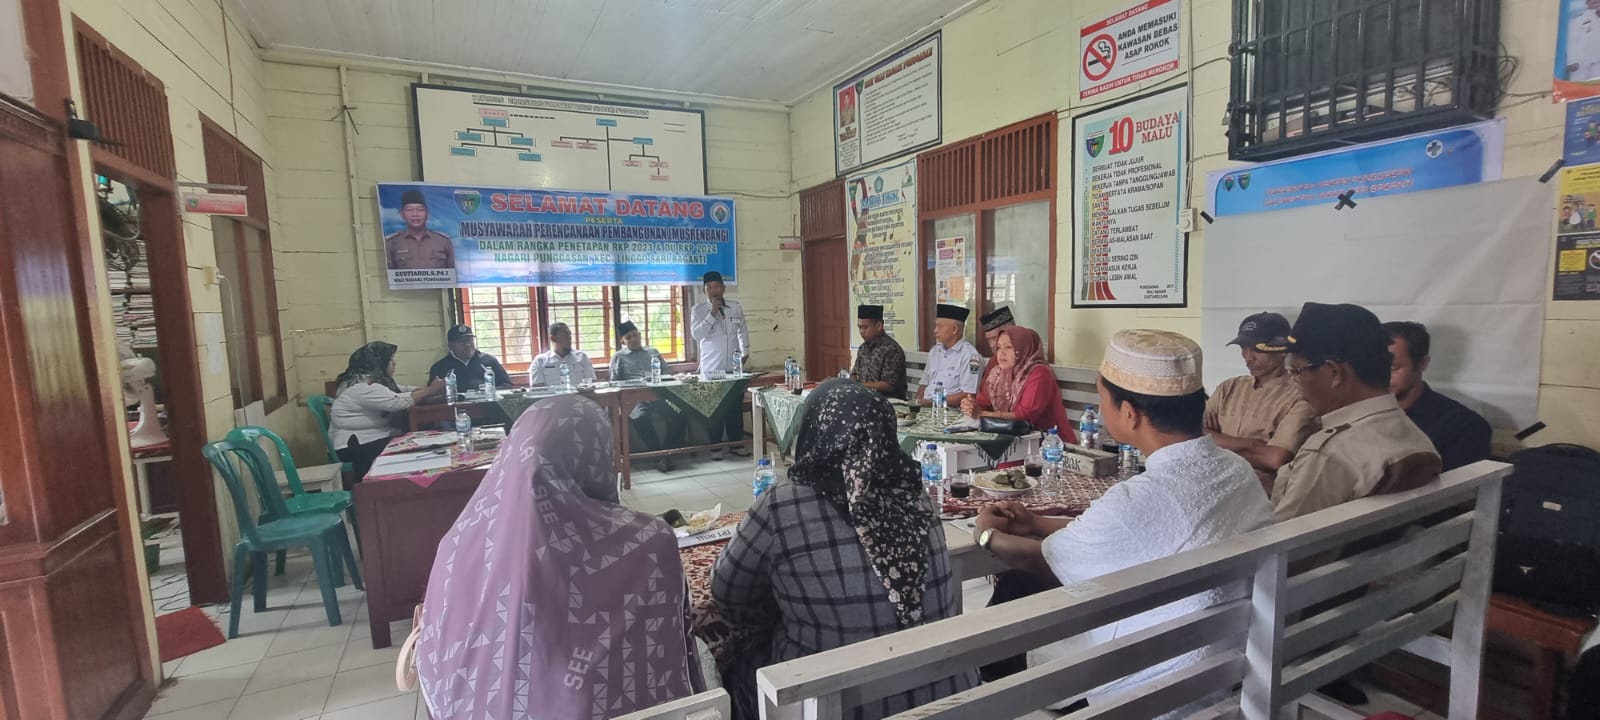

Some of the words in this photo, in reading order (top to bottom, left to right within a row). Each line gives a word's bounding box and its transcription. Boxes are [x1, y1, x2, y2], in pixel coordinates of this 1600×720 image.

[1106, 12, 1128, 26] SELAMAT
[1128, 4, 1149, 16] DATANG
[1118, 28, 1136, 40] ANDA
[1138, 12, 1176, 32] MEMASUKI
[1118, 34, 1152, 51] KAWASAN
[1154, 24, 1178, 38] BEBAS
[1124, 48, 1142, 60] ASAP
[1144, 37, 1170, 53] ROKOK
[1082, 86, 1098, 96] TERIMA
[1100, 82, 1114, 92] KASIH
[1115, 77, 1132, 87] UNTUK
[1132, 72, 1146, 80] TIDAK
[1148, 63, 1175, 76] MEROKOK
[1109, 117, 1134, 155] 10
[1136, 112, 1179, 132] BUDAYA
[1142, 126, 1173, 143] MALU
[1092, 160, 1113, 172] BERBUAT
[1114, 160, 1127, 168] TIDAK
[1128, 156, 1144, 166] JUJUR
[1092, 172, 1112, 182] BEKERJA
[1114, 169, 1126, 178] TIDAK
[1128, 163, 1162, 174] PROFESIONAL
[1092, 180, 1112, 190] BEKERJA
[1114, 178, 1128, 186] TANPA
[1130, 170, 1176, 183] TANGGUNGJAWAB
[1128, 182, 1164, 194] KRAMA/SOPAN
[491, 193, 608, 216] SELAMAT
[616, 199, 704, 220] DATANG
[1092, 208, 1128, 218] MENINGGALKAN
[1128, 204, 1144, 213] TUGAS
[1146, 201, 1170, 210] SEBELUM
[460, 222, 532, 238] MUSYAWARAH
[534, 223, 600, 239] PERENCANAAN
[602, 226, 667, 240] PEMBANGUNAN
[1111, 225, 1138, 234] TERLAMBAT
[480, 240, 516, 250] DALAM
[518, 241, 555, 251] RANGKA
[558, 242, 608, 252] PENETAPAN
[612, 242, 629, 252] RKP
[632, 243, 654, 252] 2023
[678, 244, 694, 253] RKP
[697, 244, 717, 254] 2024
[494, 253, 530, 263] NAGARI
[618, 254, 647, 264] LINGGO
[650, 255, 670, 264] SARI
[672, 256, 706, 264] BAGANTI
[1112, 254, 1128, 262] SERING
[534, 486, 558, 524] SEE
[563, 647, 594, 690] SEE
